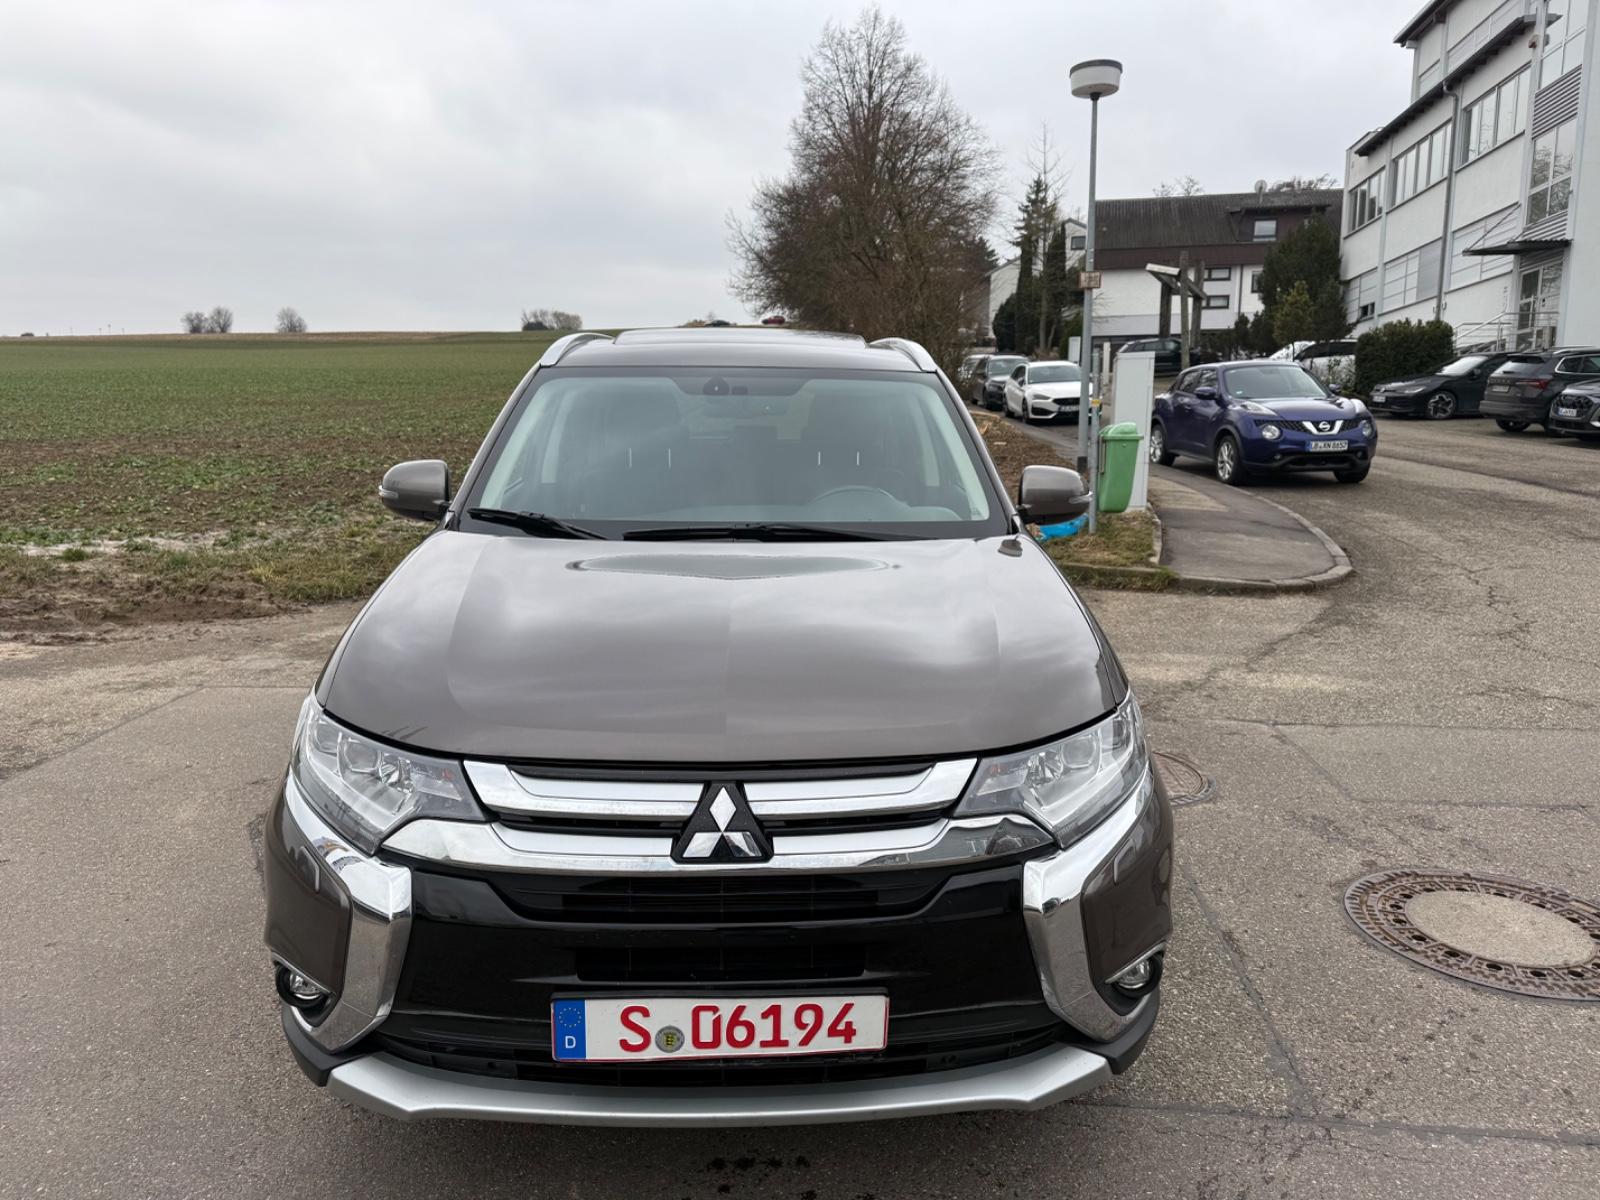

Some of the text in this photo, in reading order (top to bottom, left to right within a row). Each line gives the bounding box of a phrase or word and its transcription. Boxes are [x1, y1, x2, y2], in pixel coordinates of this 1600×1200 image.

[565, 1036, 576, 1048] D
[619, 1005, 651, 1052] S
[691, 1003, 857, 1049] 06194
